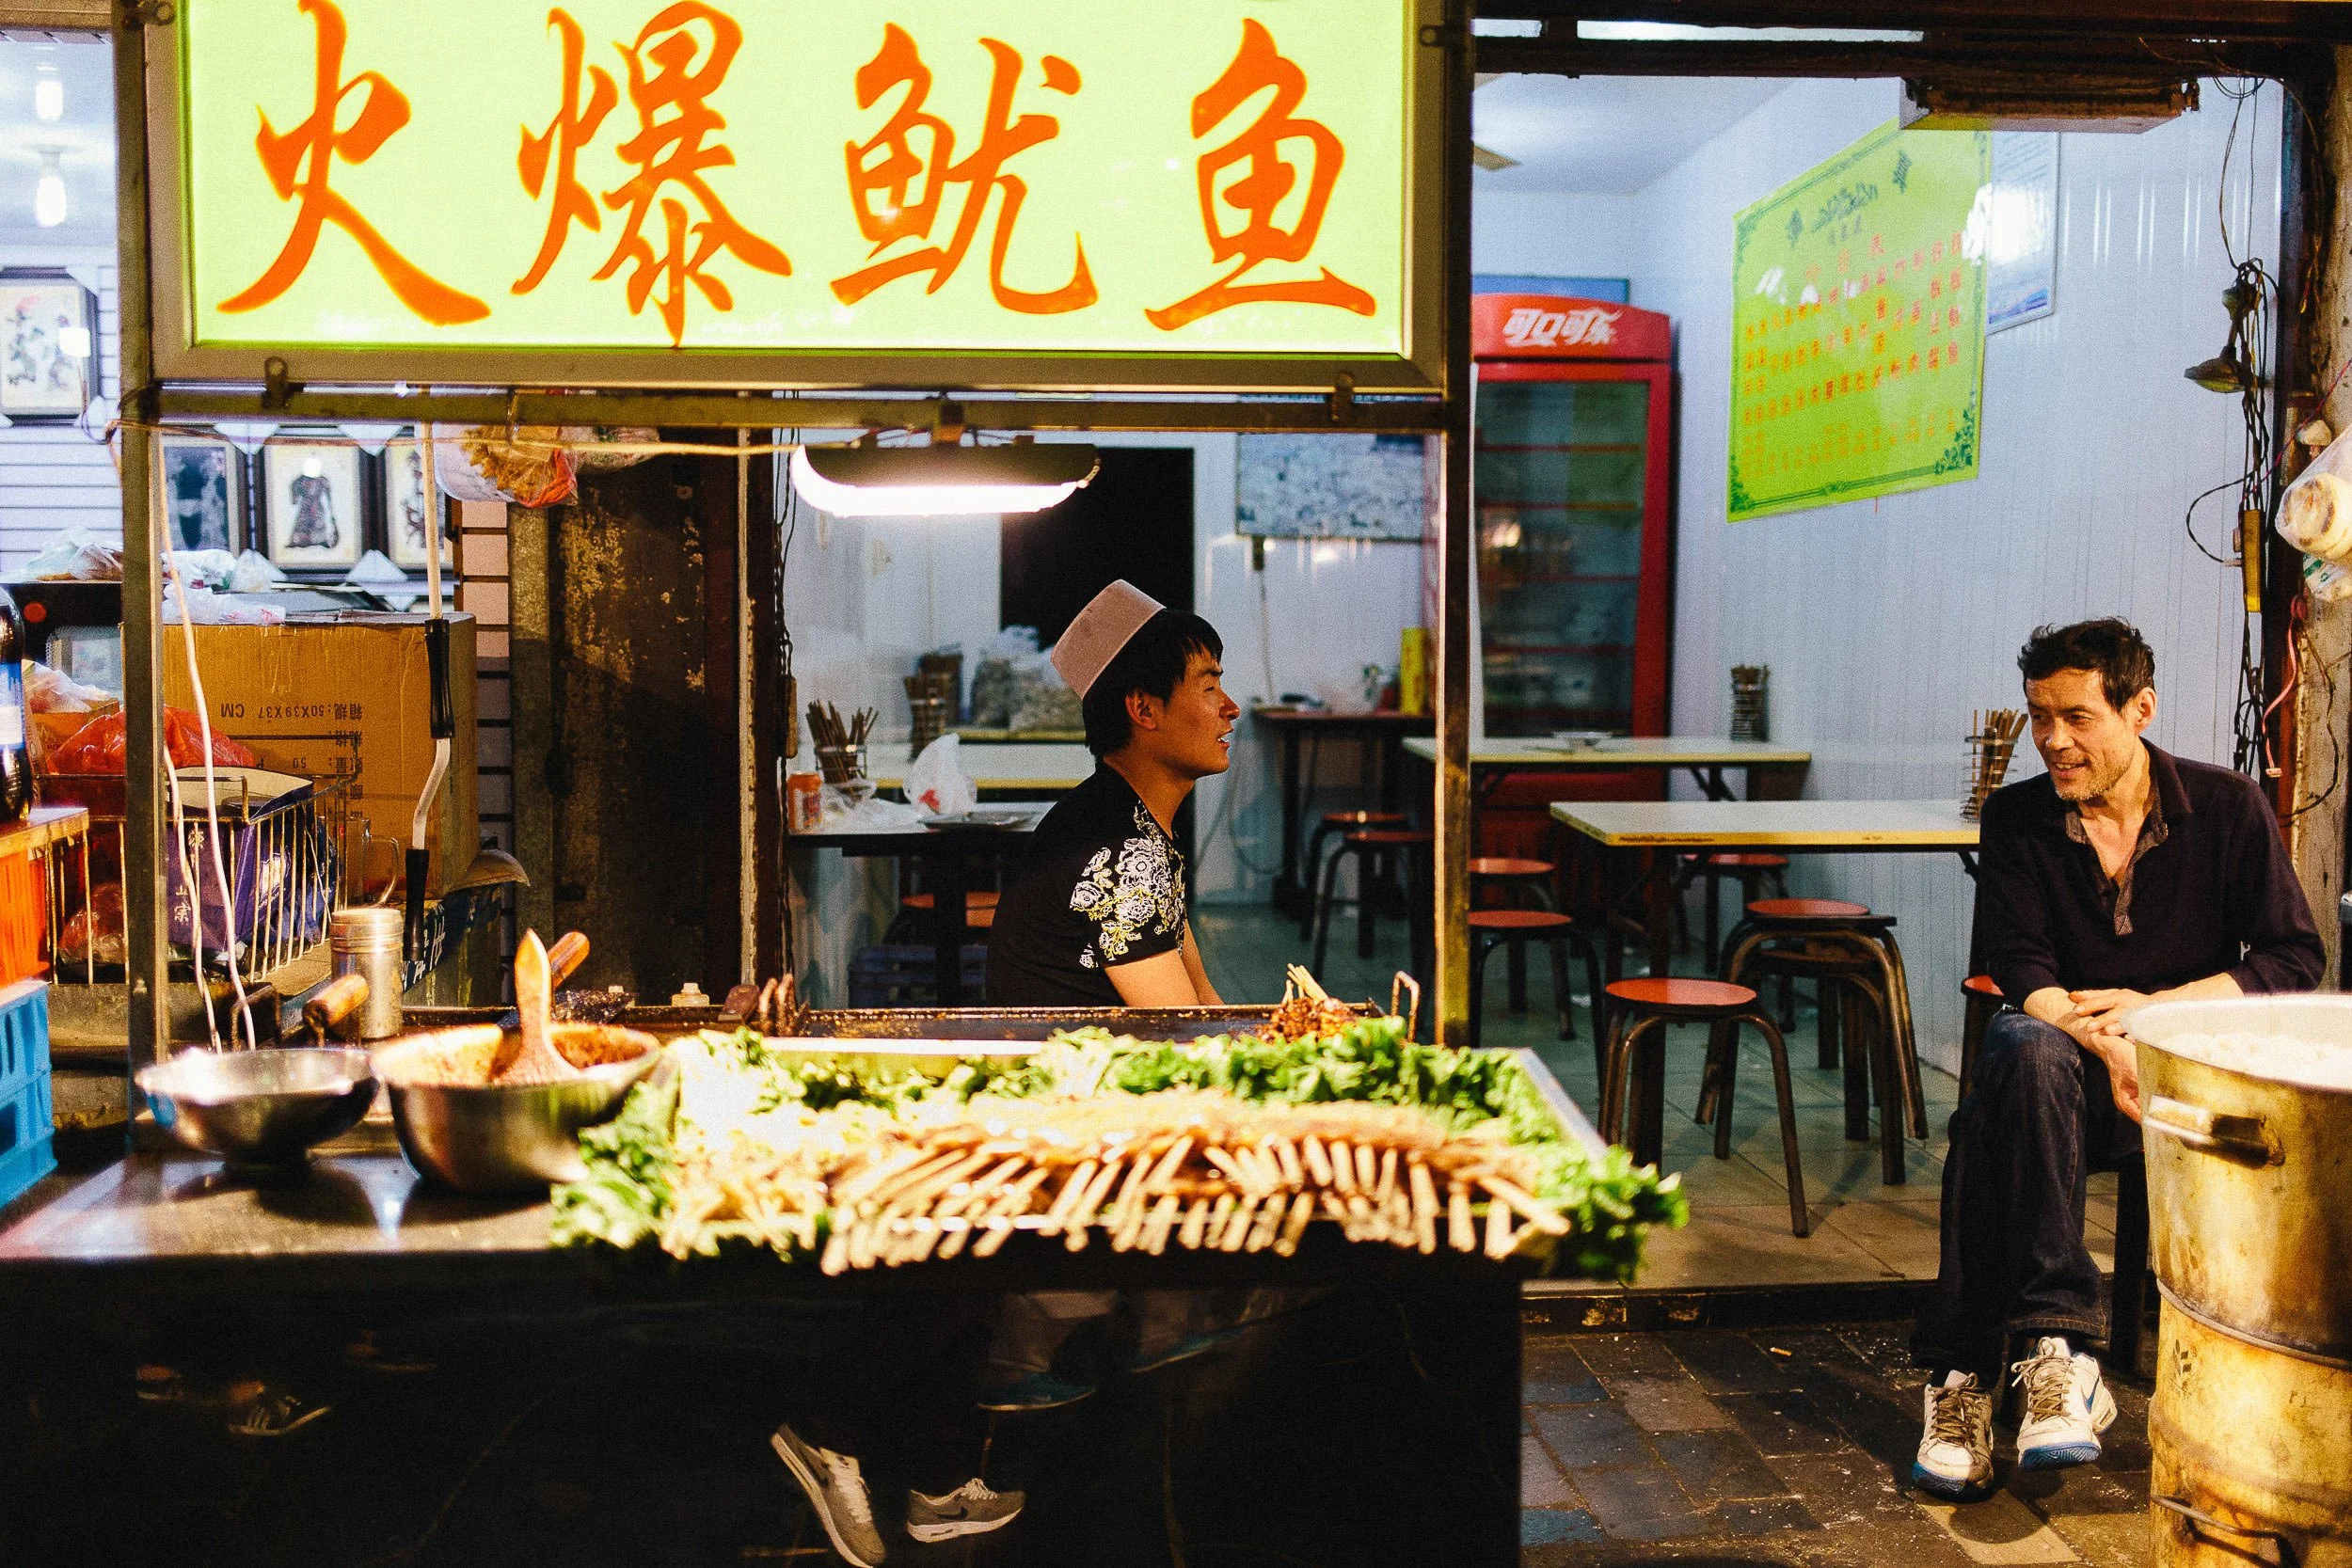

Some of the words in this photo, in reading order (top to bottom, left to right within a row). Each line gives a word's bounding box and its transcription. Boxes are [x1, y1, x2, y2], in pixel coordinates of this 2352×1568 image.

[217, 0, 1376, 347] 火爆鱿鱼
[1502, 307, 1624, 347] 可口可乐
[220, 702, 246, 719] CM
[292, 756, 308, 769] 50
